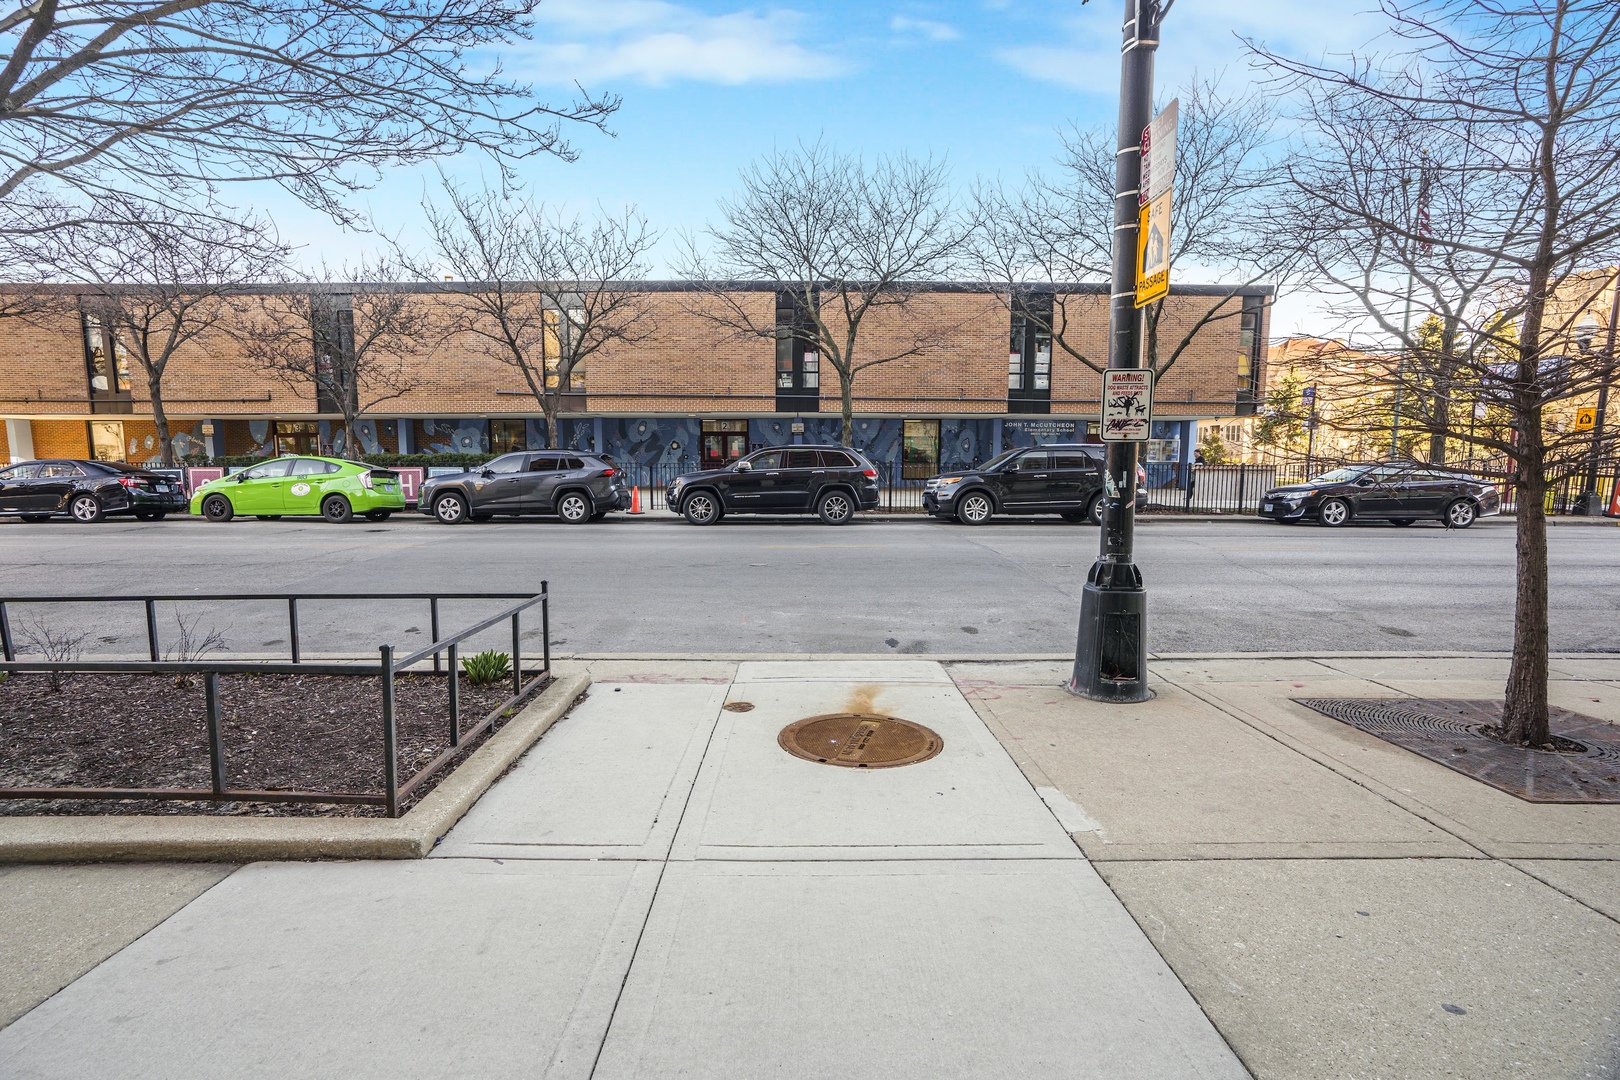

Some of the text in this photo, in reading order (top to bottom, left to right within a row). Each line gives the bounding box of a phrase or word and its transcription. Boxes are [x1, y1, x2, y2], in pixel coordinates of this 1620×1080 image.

[1147, 202, 1163, 223] SAFE
[1139, 271, 1165, 292] PASSAGE
[1112, 374, 1145, 382] WARNING!
[722, 422, 728, 430] 2
